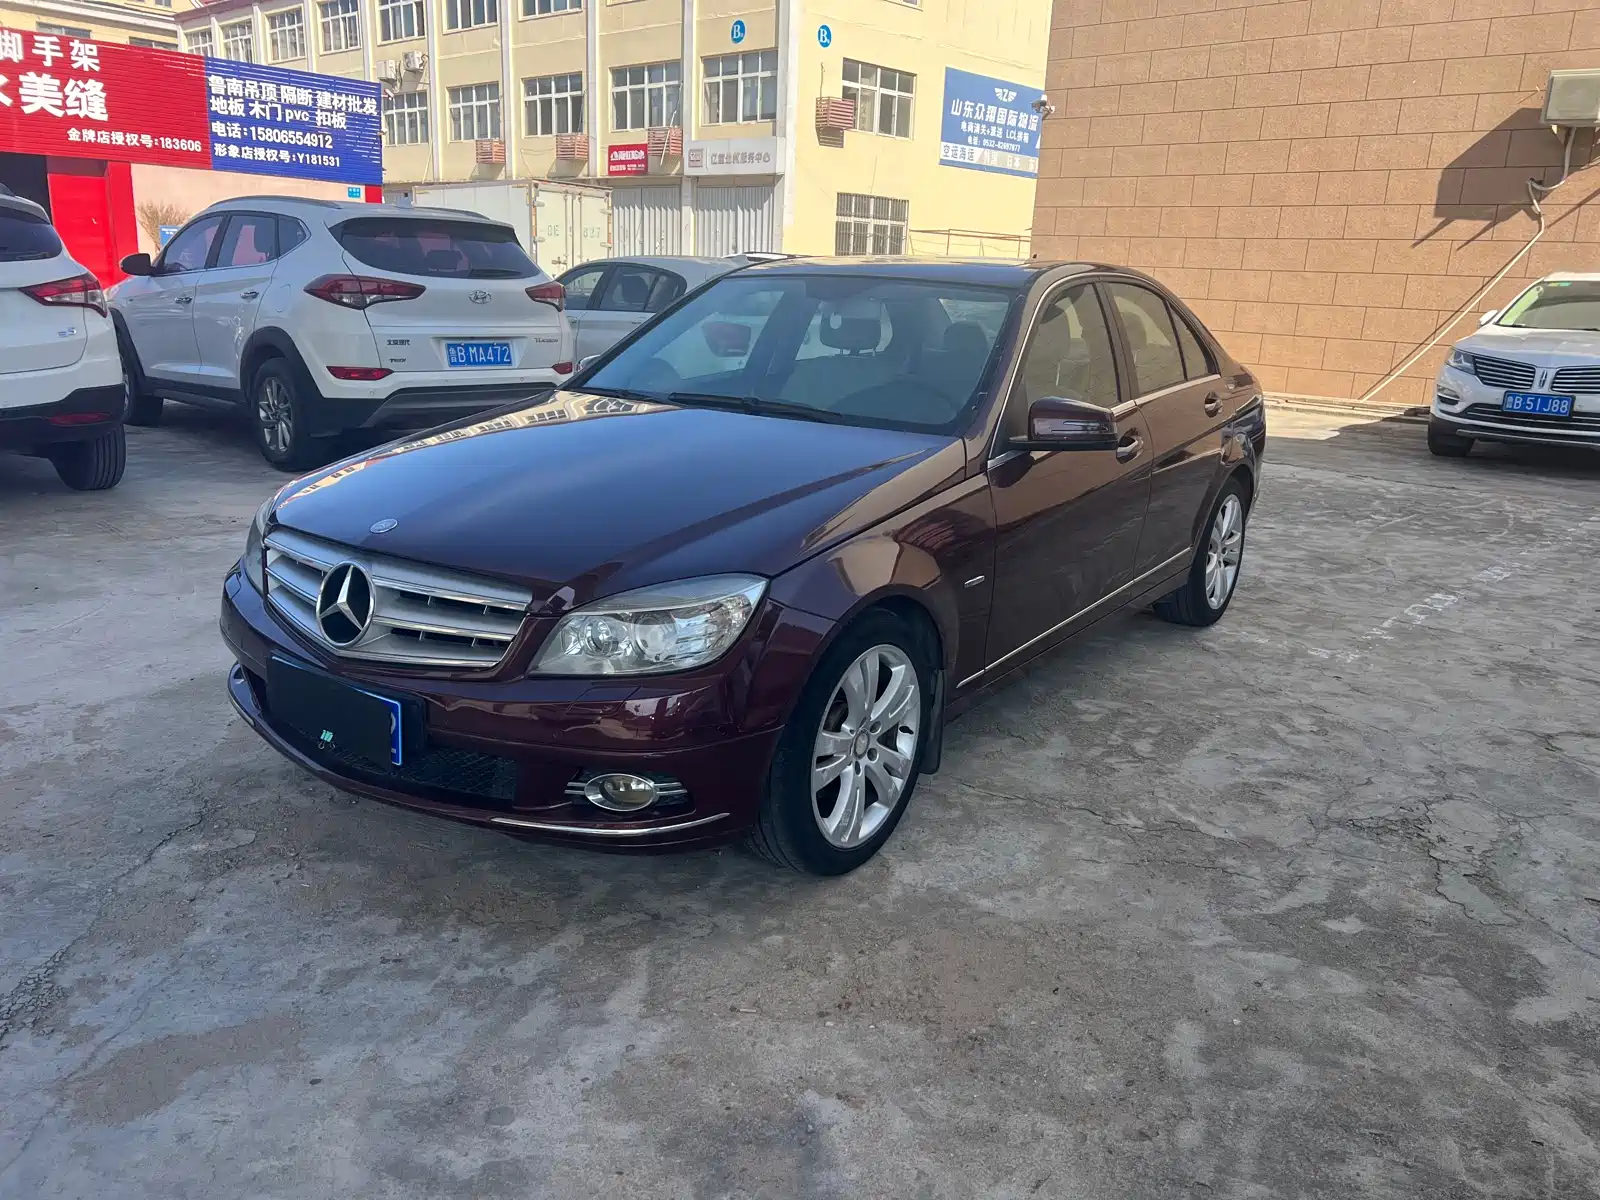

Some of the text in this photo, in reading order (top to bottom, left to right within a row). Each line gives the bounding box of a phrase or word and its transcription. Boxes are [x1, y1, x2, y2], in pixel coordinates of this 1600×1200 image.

[208, 74, 378, 117] 鲁南吊顶 隔断 建材批发
[210, 95, 347, 130] 地板 木门 pvc 扣板
[67, 127, 202, 152] 金牌店授权号:183606
[214, 142, 341, 168] 形象店授权号:Y181531
